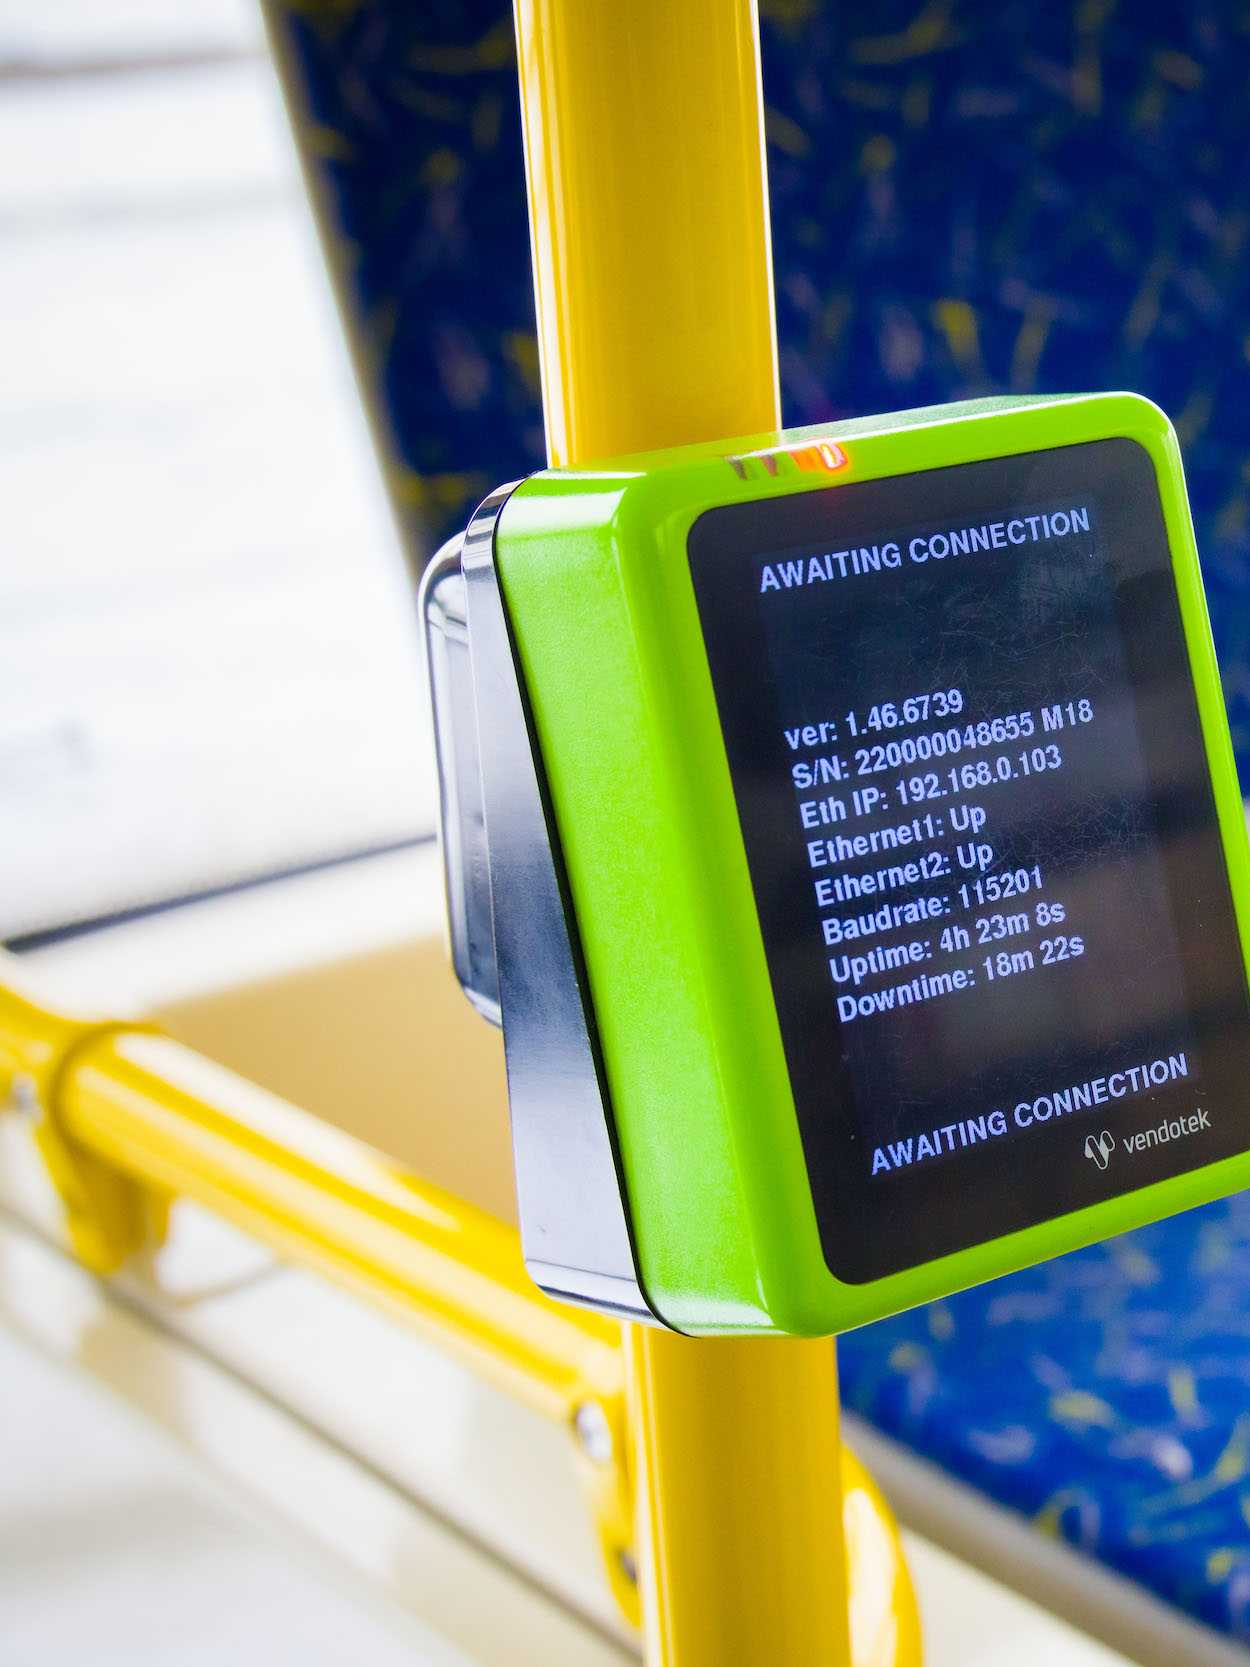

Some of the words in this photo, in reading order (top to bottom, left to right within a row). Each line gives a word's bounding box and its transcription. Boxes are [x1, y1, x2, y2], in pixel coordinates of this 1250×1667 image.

[760, 542, 902, 593] AWAITING
[908, 507, 1090, 563] CONNECTION
[784, 722, 838, 750] ver:
[845, 688, 964, 737] 1.46.6739
[791, 755, 850, 789] S/N:
[854, 711, 1035, 776] 220000048655
[1040, 698, 1094, 732] M18
[799, 796, 847, 829] Eth
[852, 787, 889, 817] IP:
[895, 744, 1062, 805] 192.168.0.103
[807, 813, 944, 868] Ethernet1:
[949, 804, 987, 834] Up
[814, 851, 951, 907] Ethernet2:
[956, 842, 994, 872] Up
[822, 896, 951, 946] Baudrate:
[958, 865, 1043, 909] 115201
[829, 941, 933, 985] Uptime:
[939, 925, 971, 953] 4h
[975, 912, 1030, 945] 23m
[1035, 902, 1066, 927] 8s
[836, 969, 976, 1023] Downtime:
[982, 950, 1035, 981] 18m
[1039, 935, 1085, 966] 22s
[872, 1110, 1008, 1175] AWAITING
[1013, 1053, 1188, 1128] CONNECTION
[1122, 1107, 1212, 1154] vendotek
